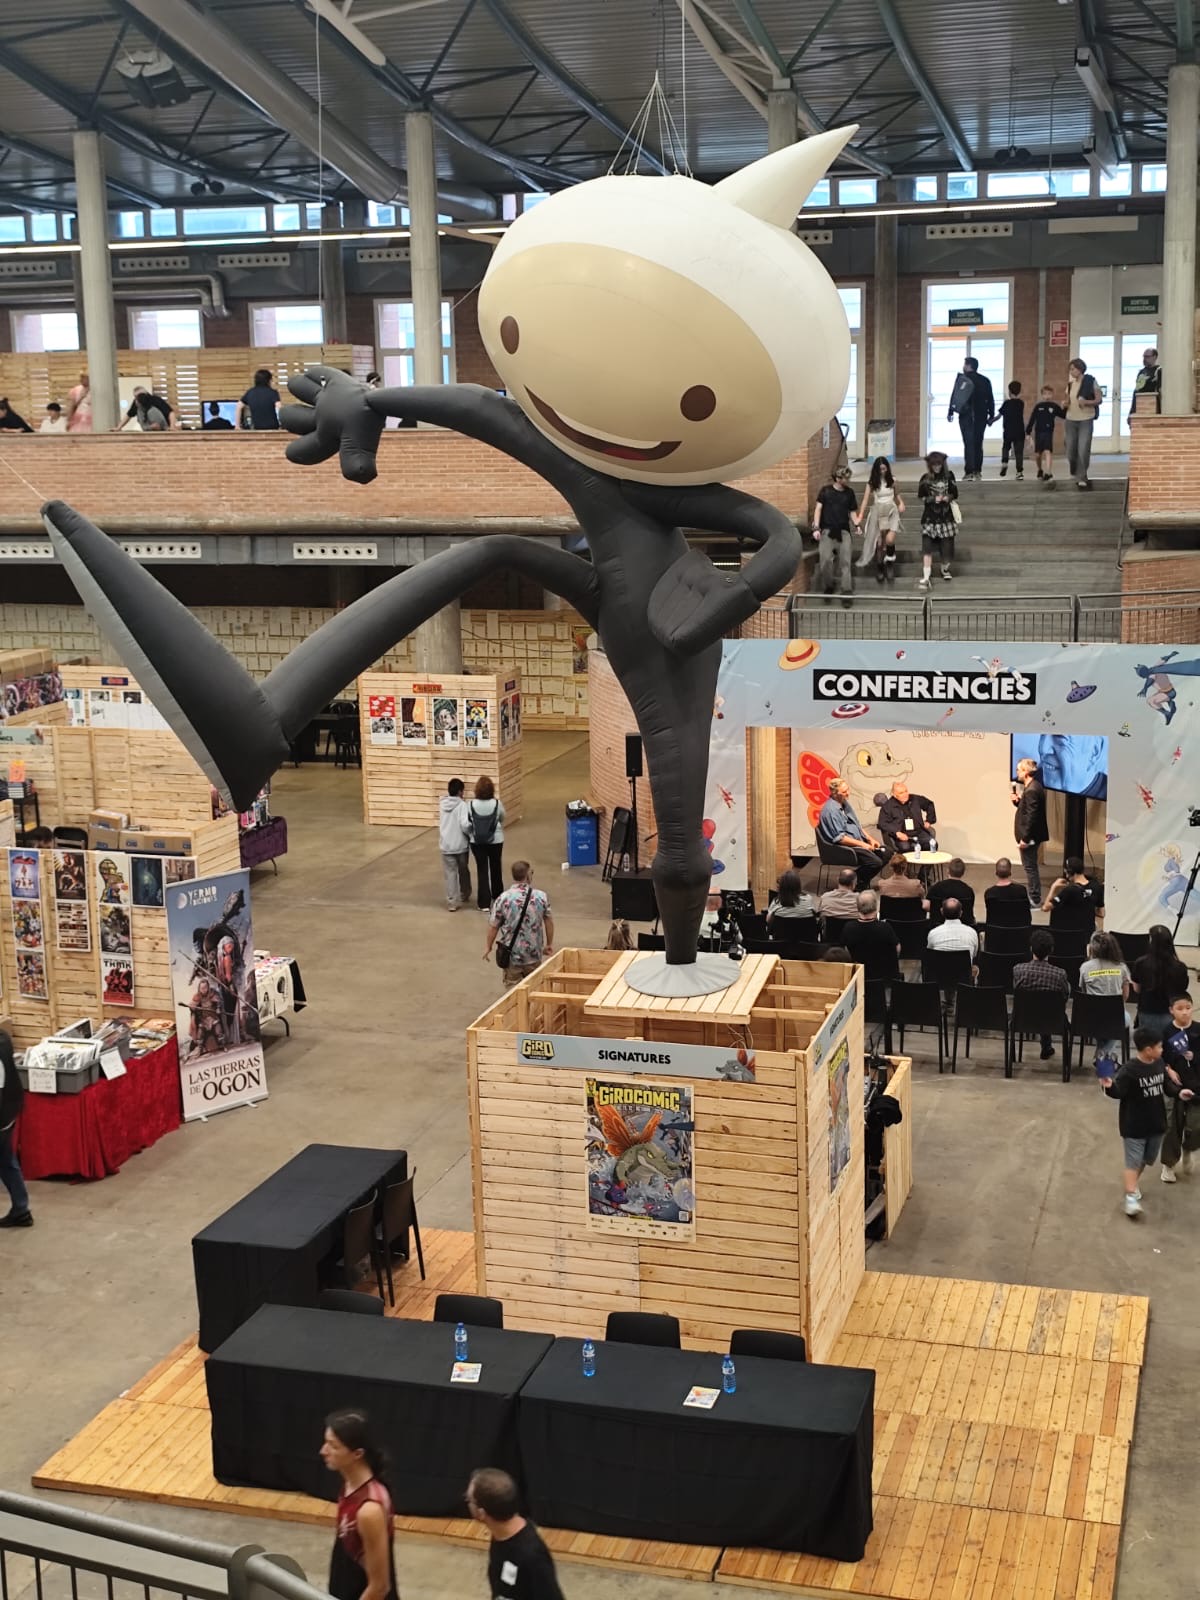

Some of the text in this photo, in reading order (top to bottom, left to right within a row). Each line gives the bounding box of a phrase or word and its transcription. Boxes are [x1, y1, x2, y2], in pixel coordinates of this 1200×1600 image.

[818, 671, 1031, 701] CONFERÈNCIES
[189, 1055, 260, 1085] LAS TIERRAS
[598, 1050, 671, 1064] SIGNATURES
[190, 1069, 260, 1101] DE OGON
